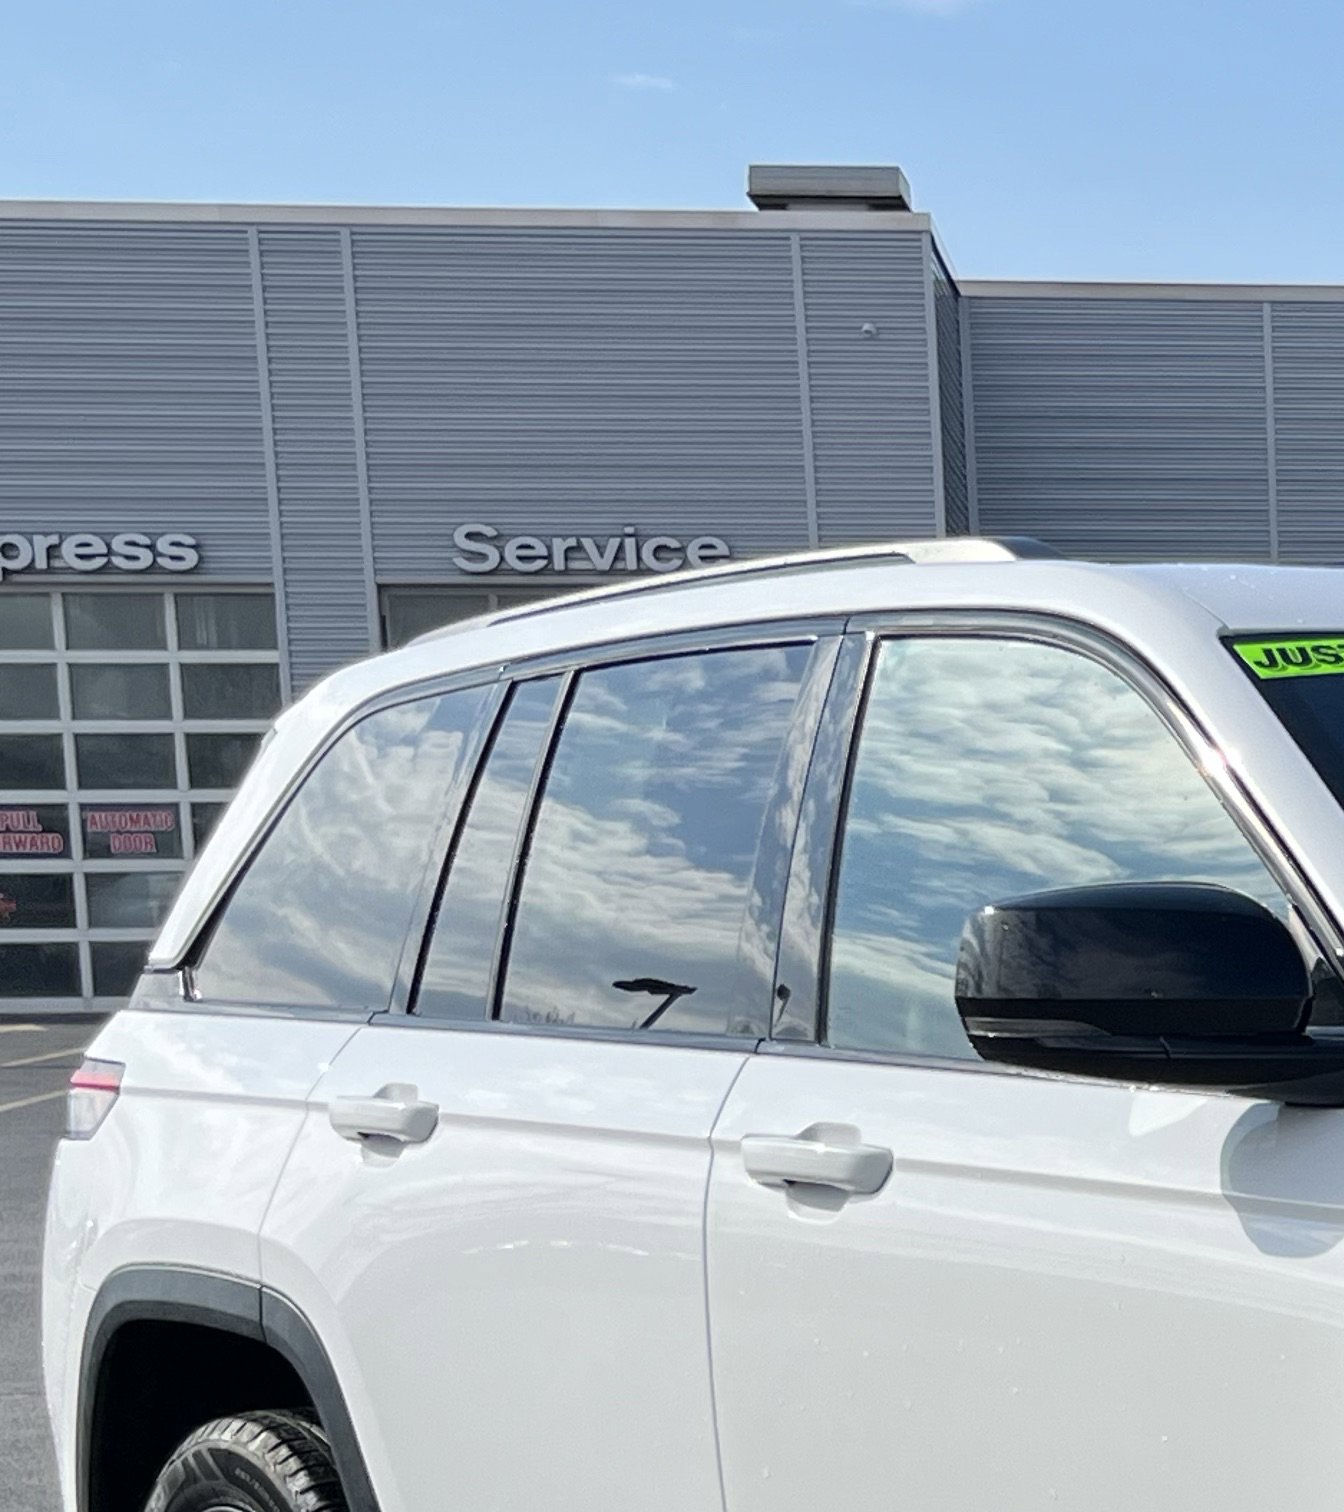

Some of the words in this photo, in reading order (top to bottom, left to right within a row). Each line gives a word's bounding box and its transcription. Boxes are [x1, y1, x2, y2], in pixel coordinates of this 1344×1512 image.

[452, 523, 730, 572] Service
[88, 812, 174, 831] AUTOMATIC
[110, 834, 156, 853] DOOR
